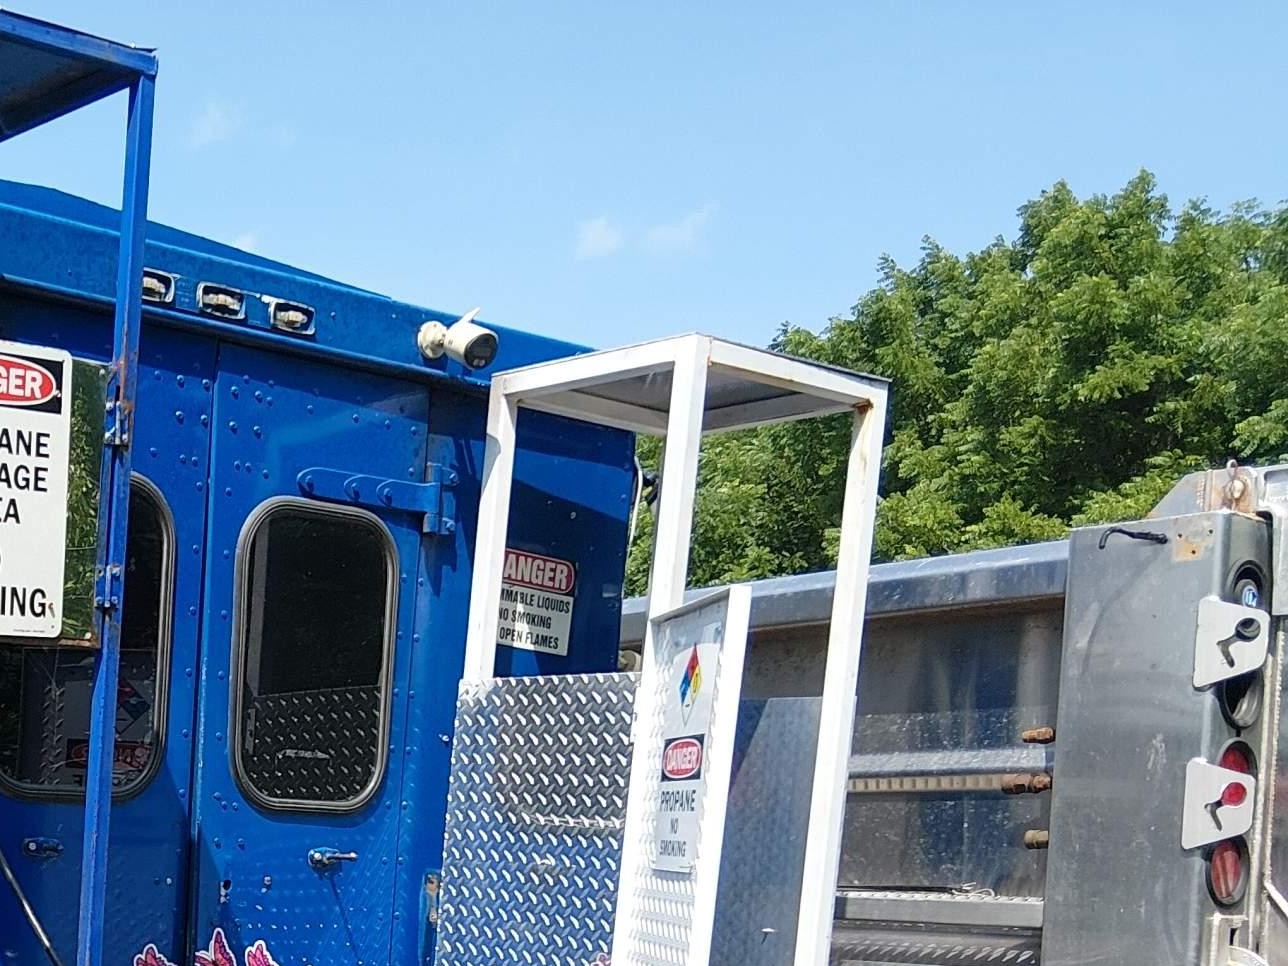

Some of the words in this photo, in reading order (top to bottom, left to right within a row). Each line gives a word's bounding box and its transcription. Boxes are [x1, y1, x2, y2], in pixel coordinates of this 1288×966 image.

[503, 553, 569, 590] ANGER
[500, 588, 535, 607] MMABLE
[537, 595, 570, 614] LIQUIDS
[511, 610, 552, 629] SMOKING
[499, 627, 523, 643] OPEN
[525, 632, 559, 650] FLAMES
[666, 746, 698, 771] DANGER
[660, 789, 696, 812] PROPANE
[669, 817, 679, 834] NO
[659, 840, 687, 857] SMOKING
